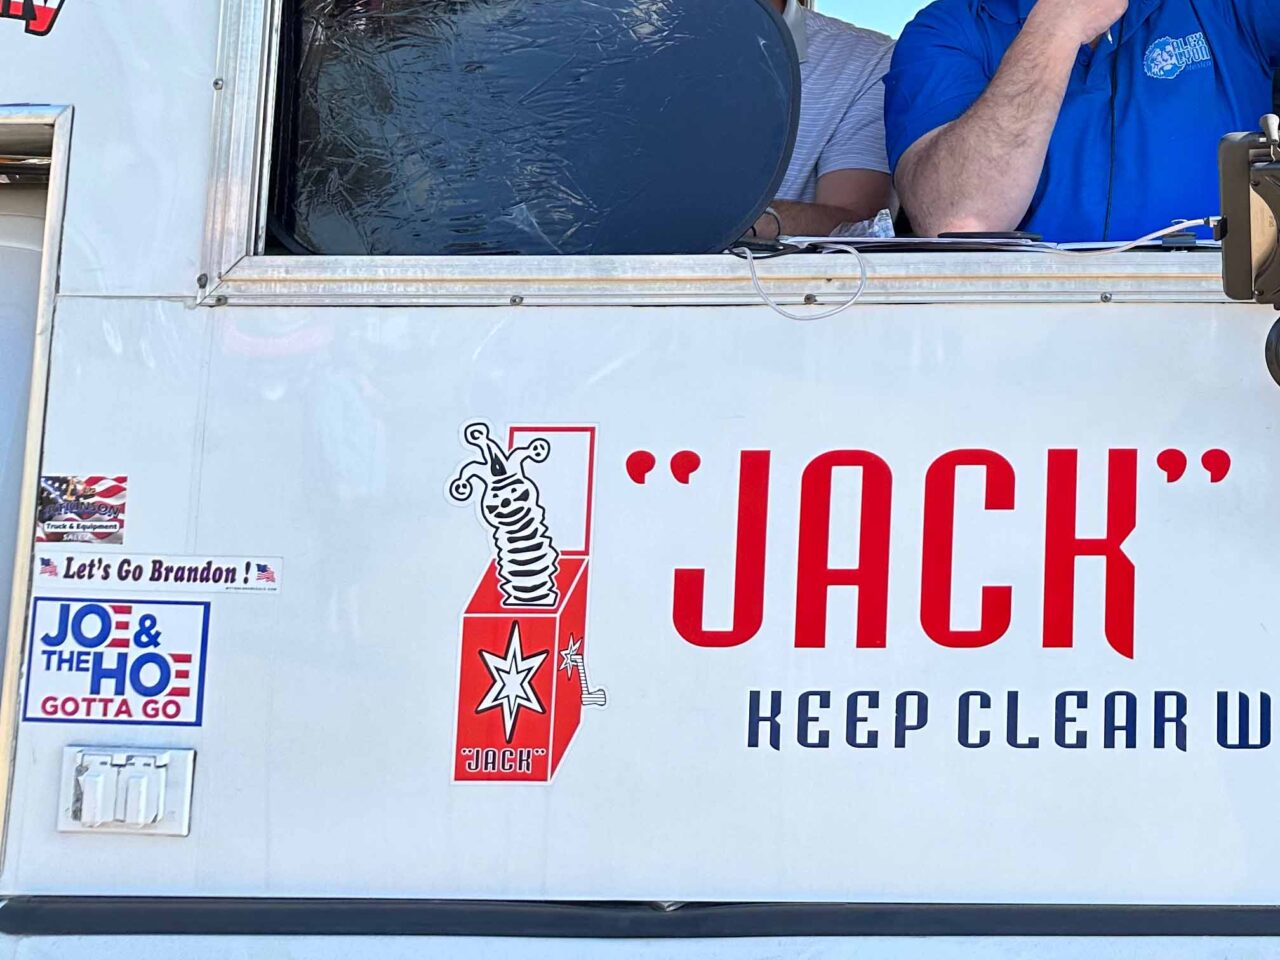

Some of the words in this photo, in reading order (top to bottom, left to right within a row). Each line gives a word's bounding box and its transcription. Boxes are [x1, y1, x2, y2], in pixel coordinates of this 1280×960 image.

[1171, 31, 1205, 52] ALEX
[76, 523, 117, 532] Equipment
[63, 557, 111, 580] Let's
[117, 558, 143, 581] Go
[149, 560, 236, 584] Brandon
[41, 603, 132, 648] JOE
[133, 614, 162, 648] &
[41, 650, 91, 672] THE
[89, 651, 192, 697] HOE
[41, 696, 133, 718] GOTTA
[142, 699, 181, 719] GO
[747, 691, 929, 751] KEEP
[957, 691, 1188, 753] CLEAR
[461, 748, 547, 773] "JACK"
